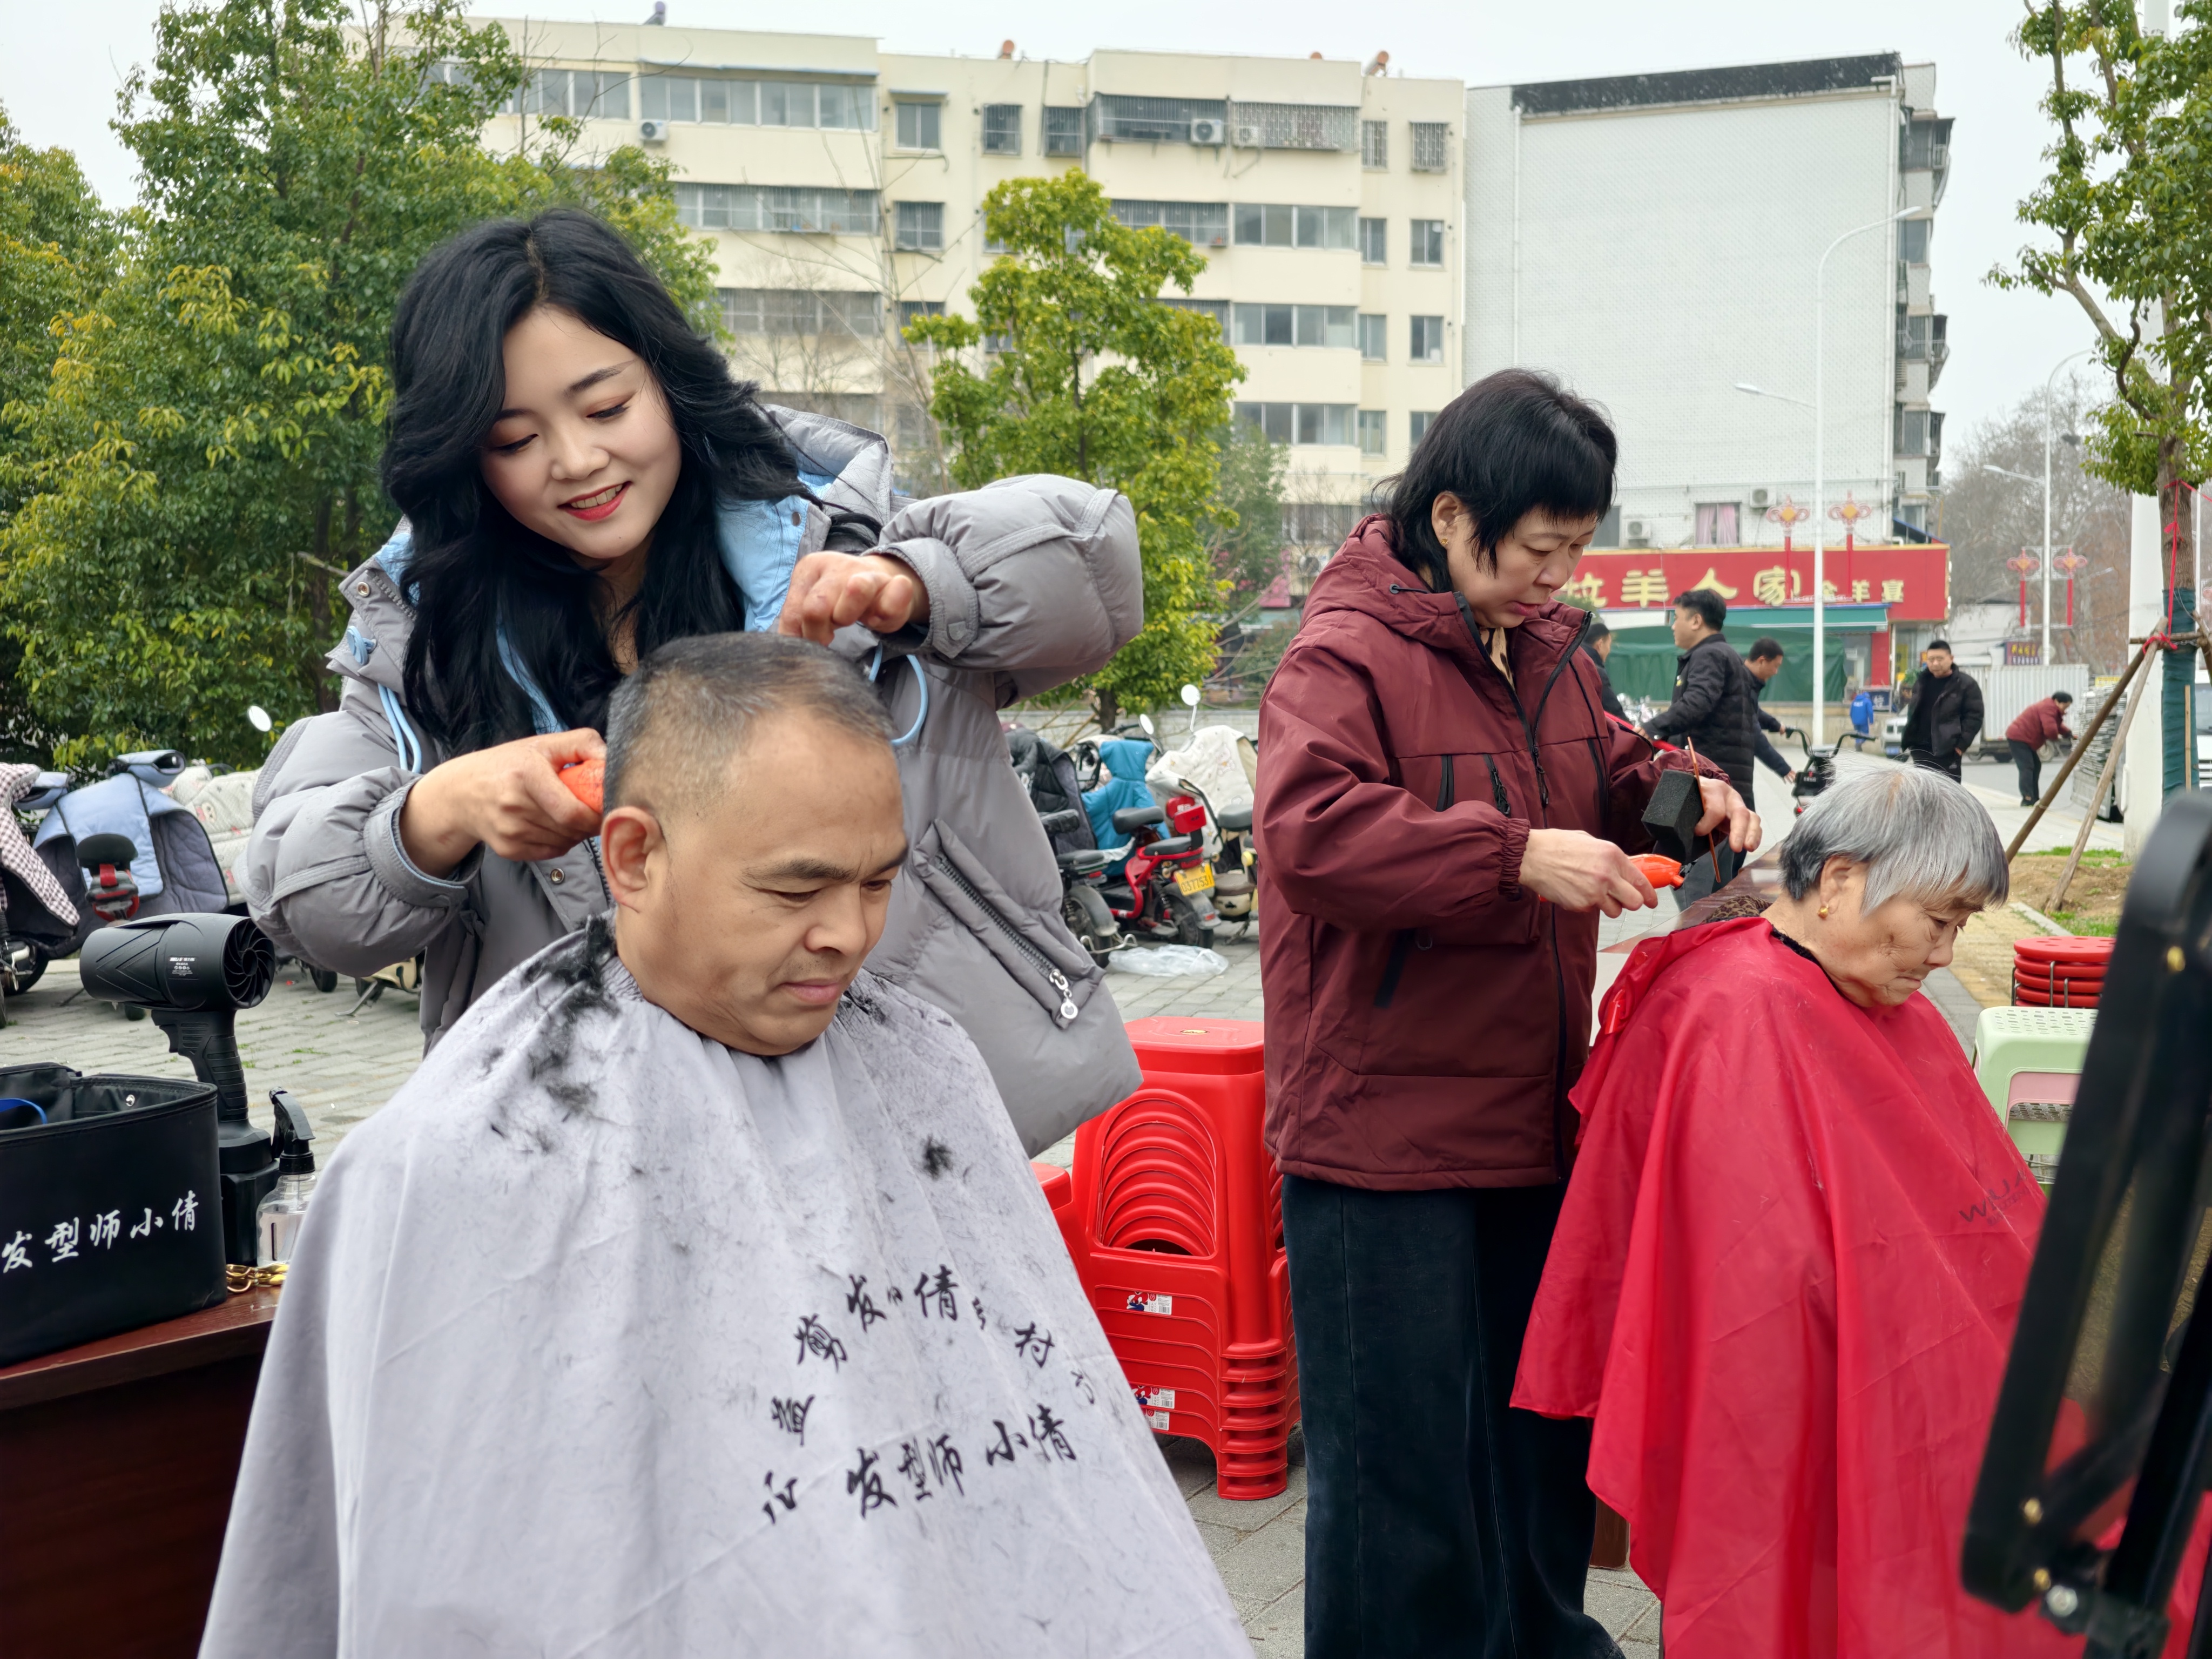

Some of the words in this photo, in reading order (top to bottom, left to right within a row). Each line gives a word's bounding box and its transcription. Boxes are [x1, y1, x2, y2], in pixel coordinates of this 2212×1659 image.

[1, 1190, 199, 1274] 发型师小倩
[846, 1402, 1077, 1520] 发型师小倩
